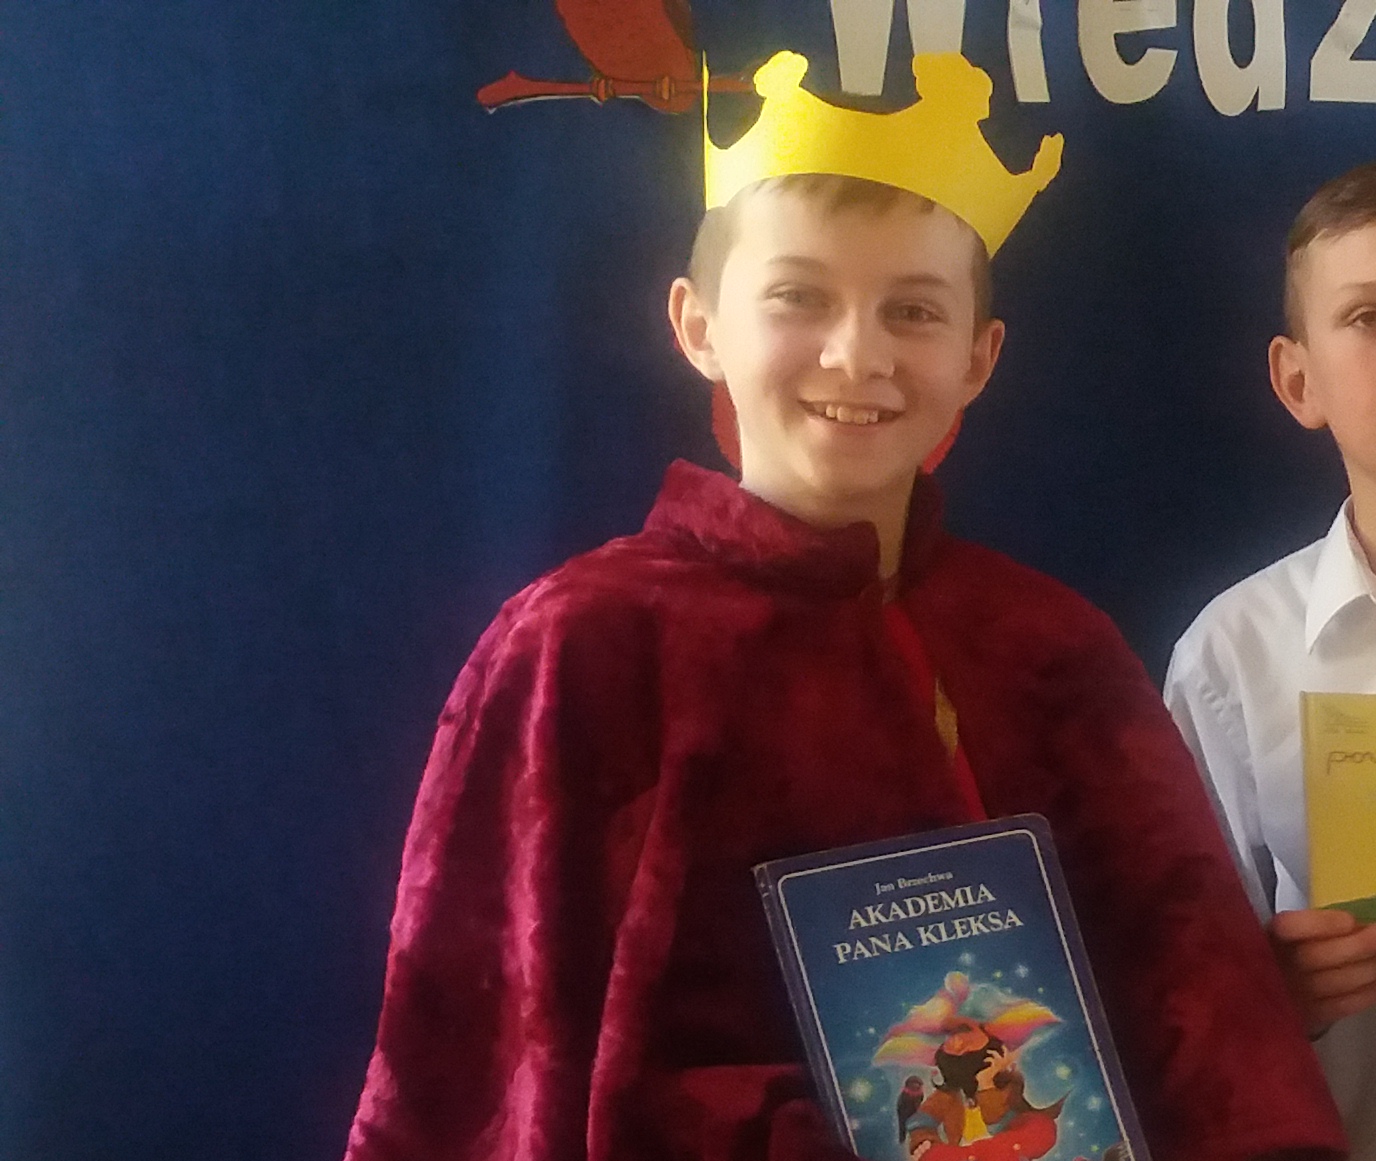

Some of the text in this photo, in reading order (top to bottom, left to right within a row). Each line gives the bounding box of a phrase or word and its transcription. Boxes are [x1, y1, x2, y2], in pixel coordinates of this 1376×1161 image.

[849, 883, 997, 930] AKADEMIA
[874, 882, 895, 896] Jan
[833, 908, 1025, 964] PANA KLEKSA
